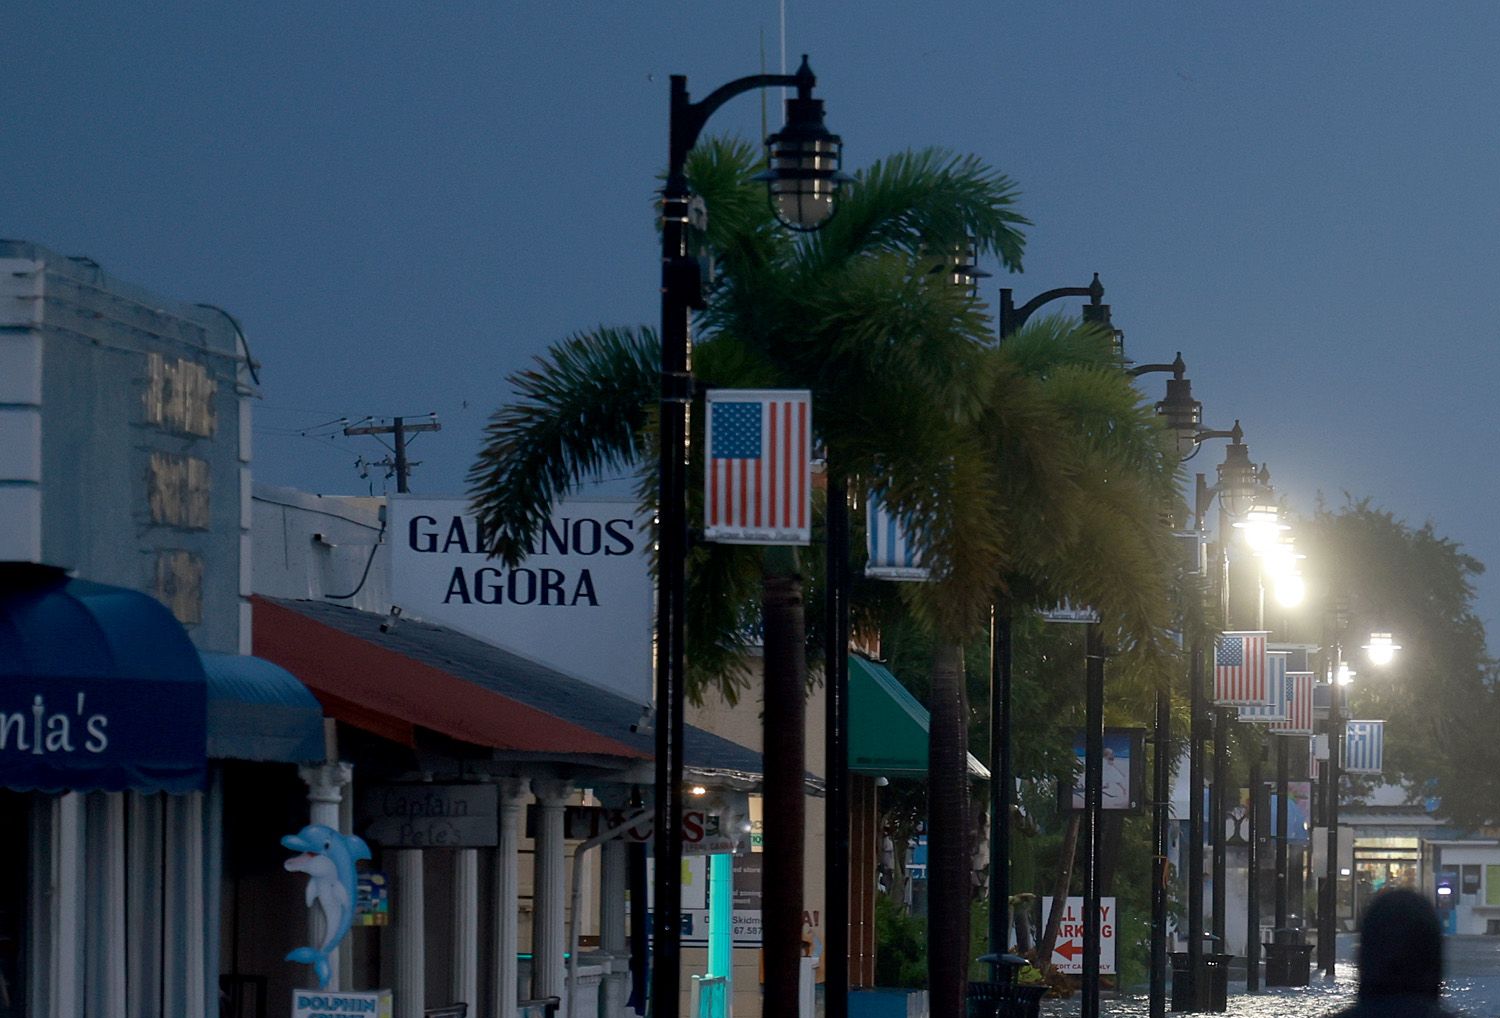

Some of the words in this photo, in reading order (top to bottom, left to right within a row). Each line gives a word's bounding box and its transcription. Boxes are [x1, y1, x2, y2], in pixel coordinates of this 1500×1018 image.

[409, 515, 634, 556] GALNOS
[442, 567, 598, 606] AGORA
[297, 995, 376, 1013] DOLPHIN
